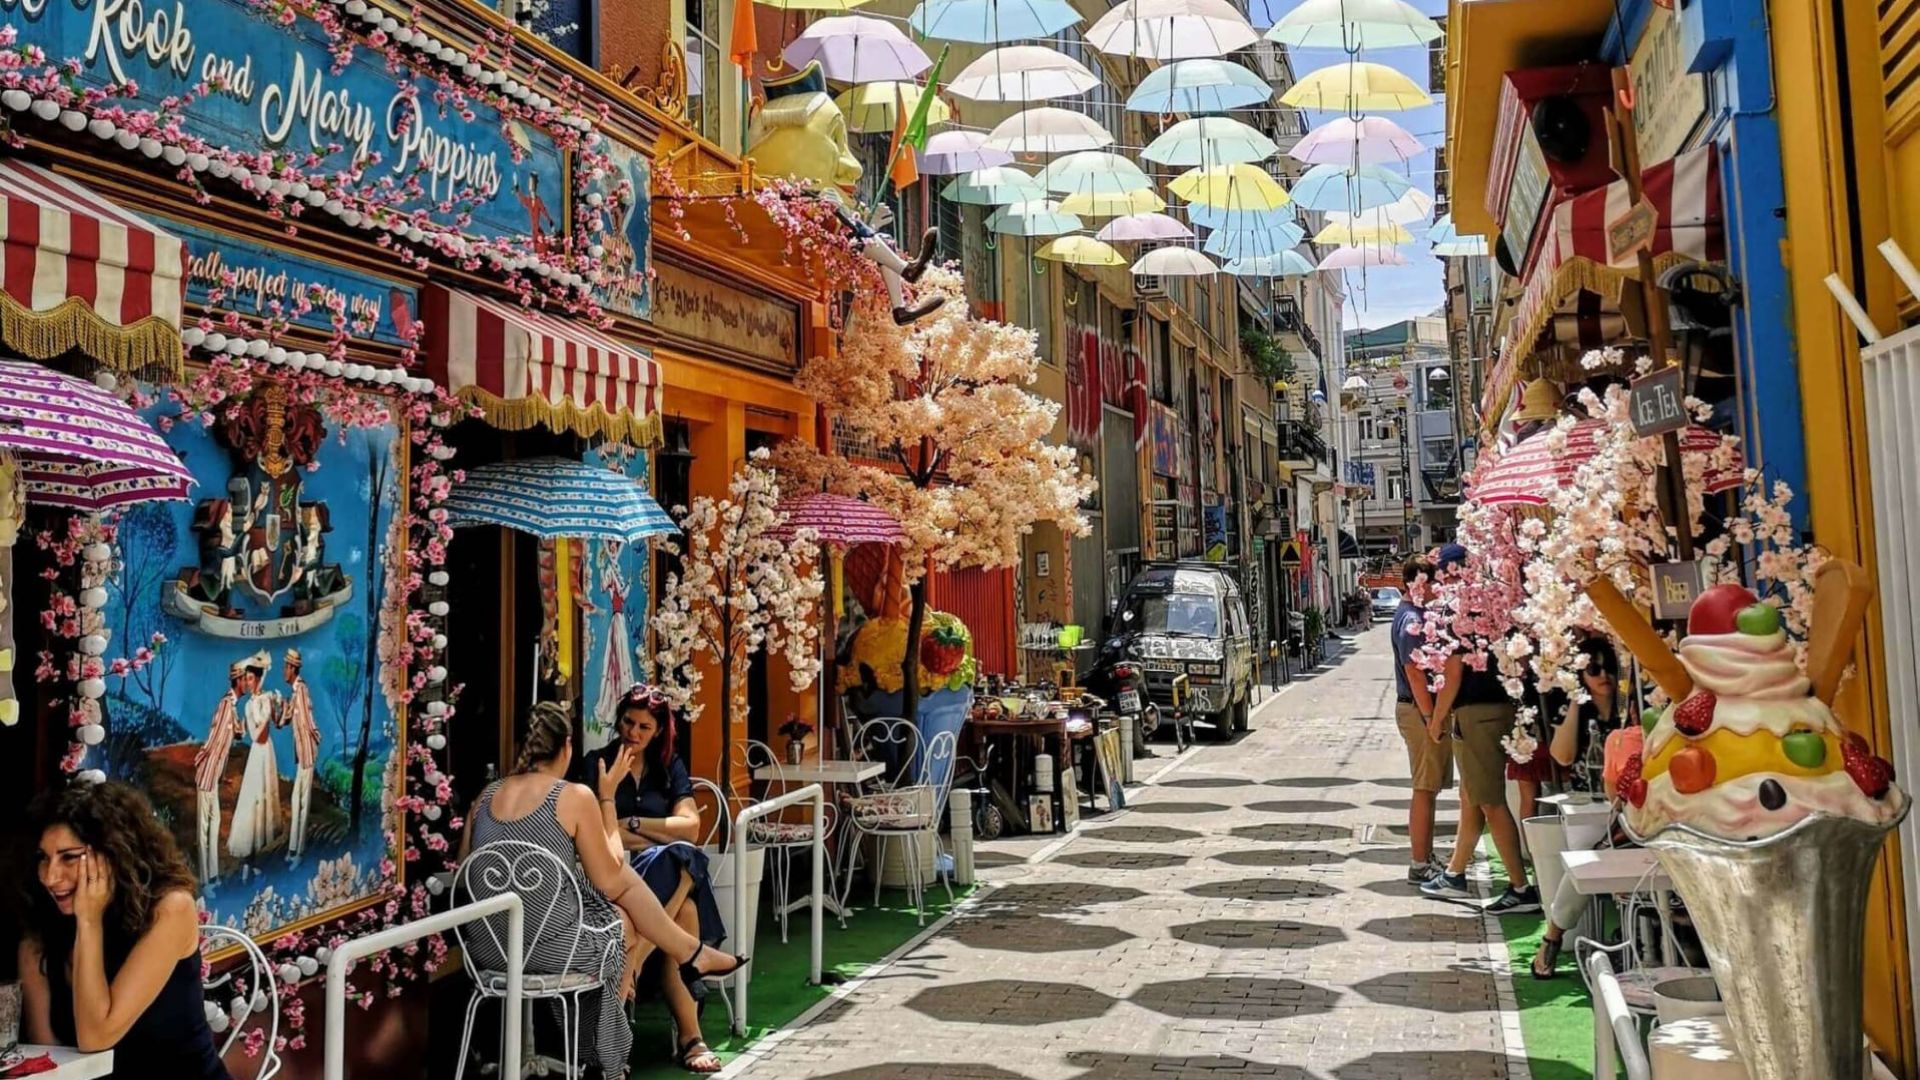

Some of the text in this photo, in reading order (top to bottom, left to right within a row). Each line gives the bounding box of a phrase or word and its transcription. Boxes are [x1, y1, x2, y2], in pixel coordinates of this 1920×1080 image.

[202, 53, 255, 98] and
[261, 51, 376, 182] Mary
[386, 91, 501, 202] Poppins
[233, 266, 288, 311] perfect
